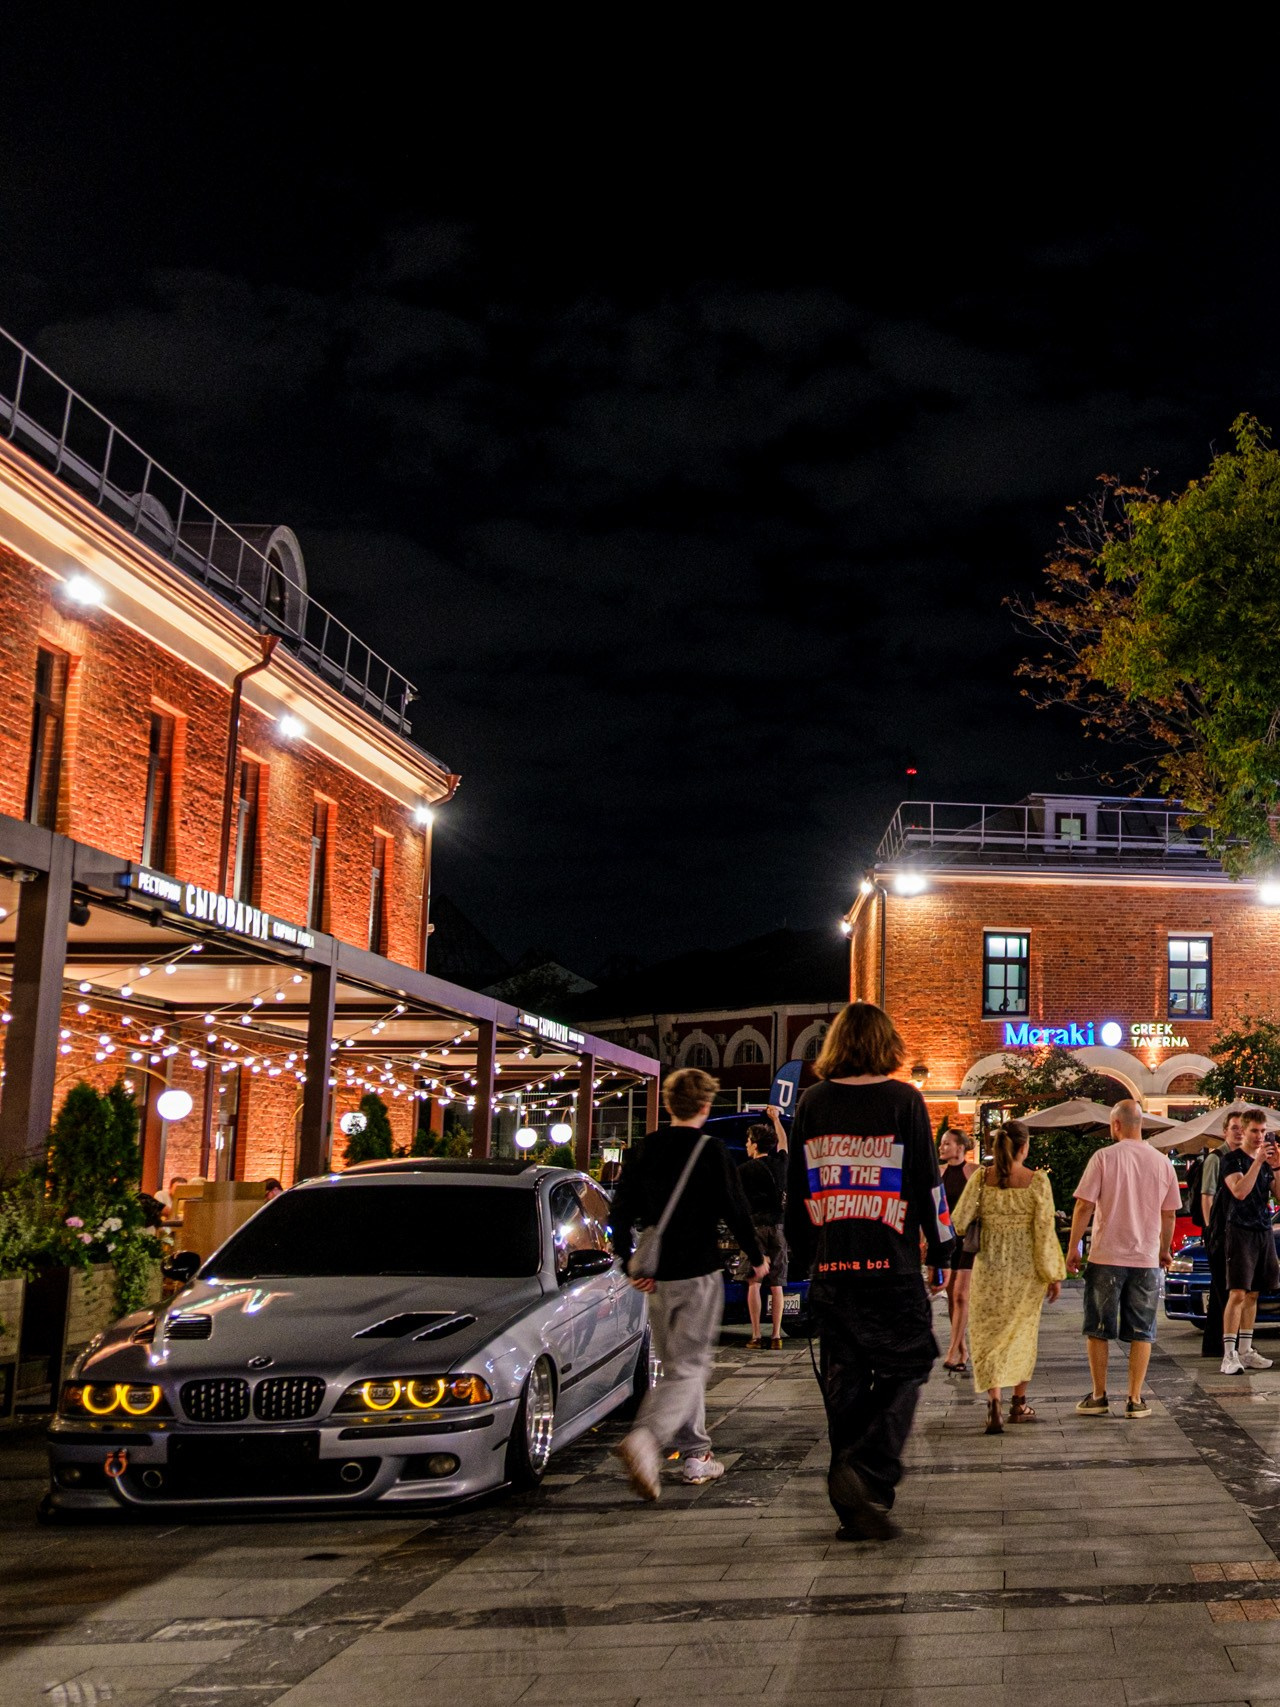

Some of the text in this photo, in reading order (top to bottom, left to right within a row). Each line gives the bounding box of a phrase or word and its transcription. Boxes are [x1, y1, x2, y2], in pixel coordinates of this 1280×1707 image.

[185, 884, 269, 941] СЫРОВАРНЯ
[1005, 1021, 1095, 1046] Meraki
[1130, 1023, 1173, 1035] GREEK
[1131, 1036, 1190, 1048] TAVERNA
[863, 1135, 894, 1157] OUT
[849, 1166, 881, 1186] THE
[826, 1194, 882, 1222] BEHIND
[883, 1197, 908, 1234] ME
[867, 1258, 890, 1270] boi
